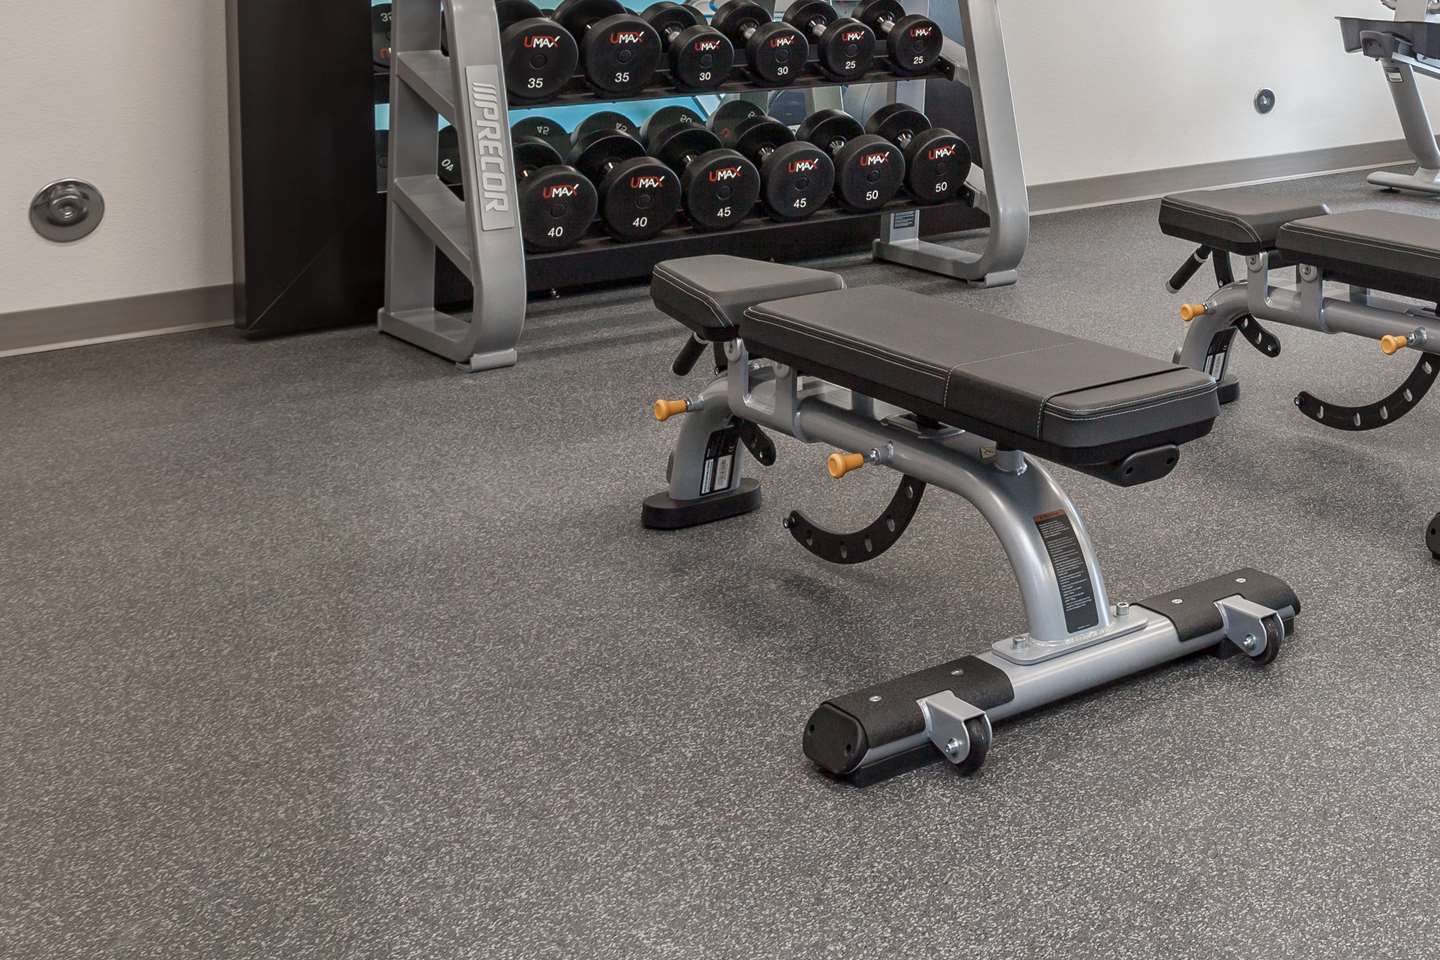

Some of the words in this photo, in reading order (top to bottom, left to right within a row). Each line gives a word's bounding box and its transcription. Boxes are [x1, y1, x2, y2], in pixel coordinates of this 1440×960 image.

[608, 31, 645, 45] UMAX
[841, 30, 865, 42] UMAX
[909, 26, 933, 38] UMAX
[524, 35, 561, 49] UMAX
[694, 39, 721, 51] UMAX
[770, 35, 795, 48] UMAX
[845, 60, 856, 70] 25
[913, 56, 924, 65] 25
[699, 71, 712, 81] 30
[777, 66, 789, 76] 30
[527, 77, 544, 89] 35
[614, 72, 630, 83] 35
[472, 94, 509, 213] PRECOR
[928, 144, 957, 160] UMAX
[859, 151, 890, 167] UMAX
[788, 158, 820, 173] UMAX
[708, 166, 742, 182] UMAX
[630, 176, 665, 189] UMAX
[935, 182, 947, 193] 50
[543, 183, 580, 199] UMAX
[866, 190, 879, 201] 50
[793, 198, 807, 208] 45
[717, 207, 731, 217] 45
[632, 217, 648, 228] 40
[547, 226, 564, 238] 40
